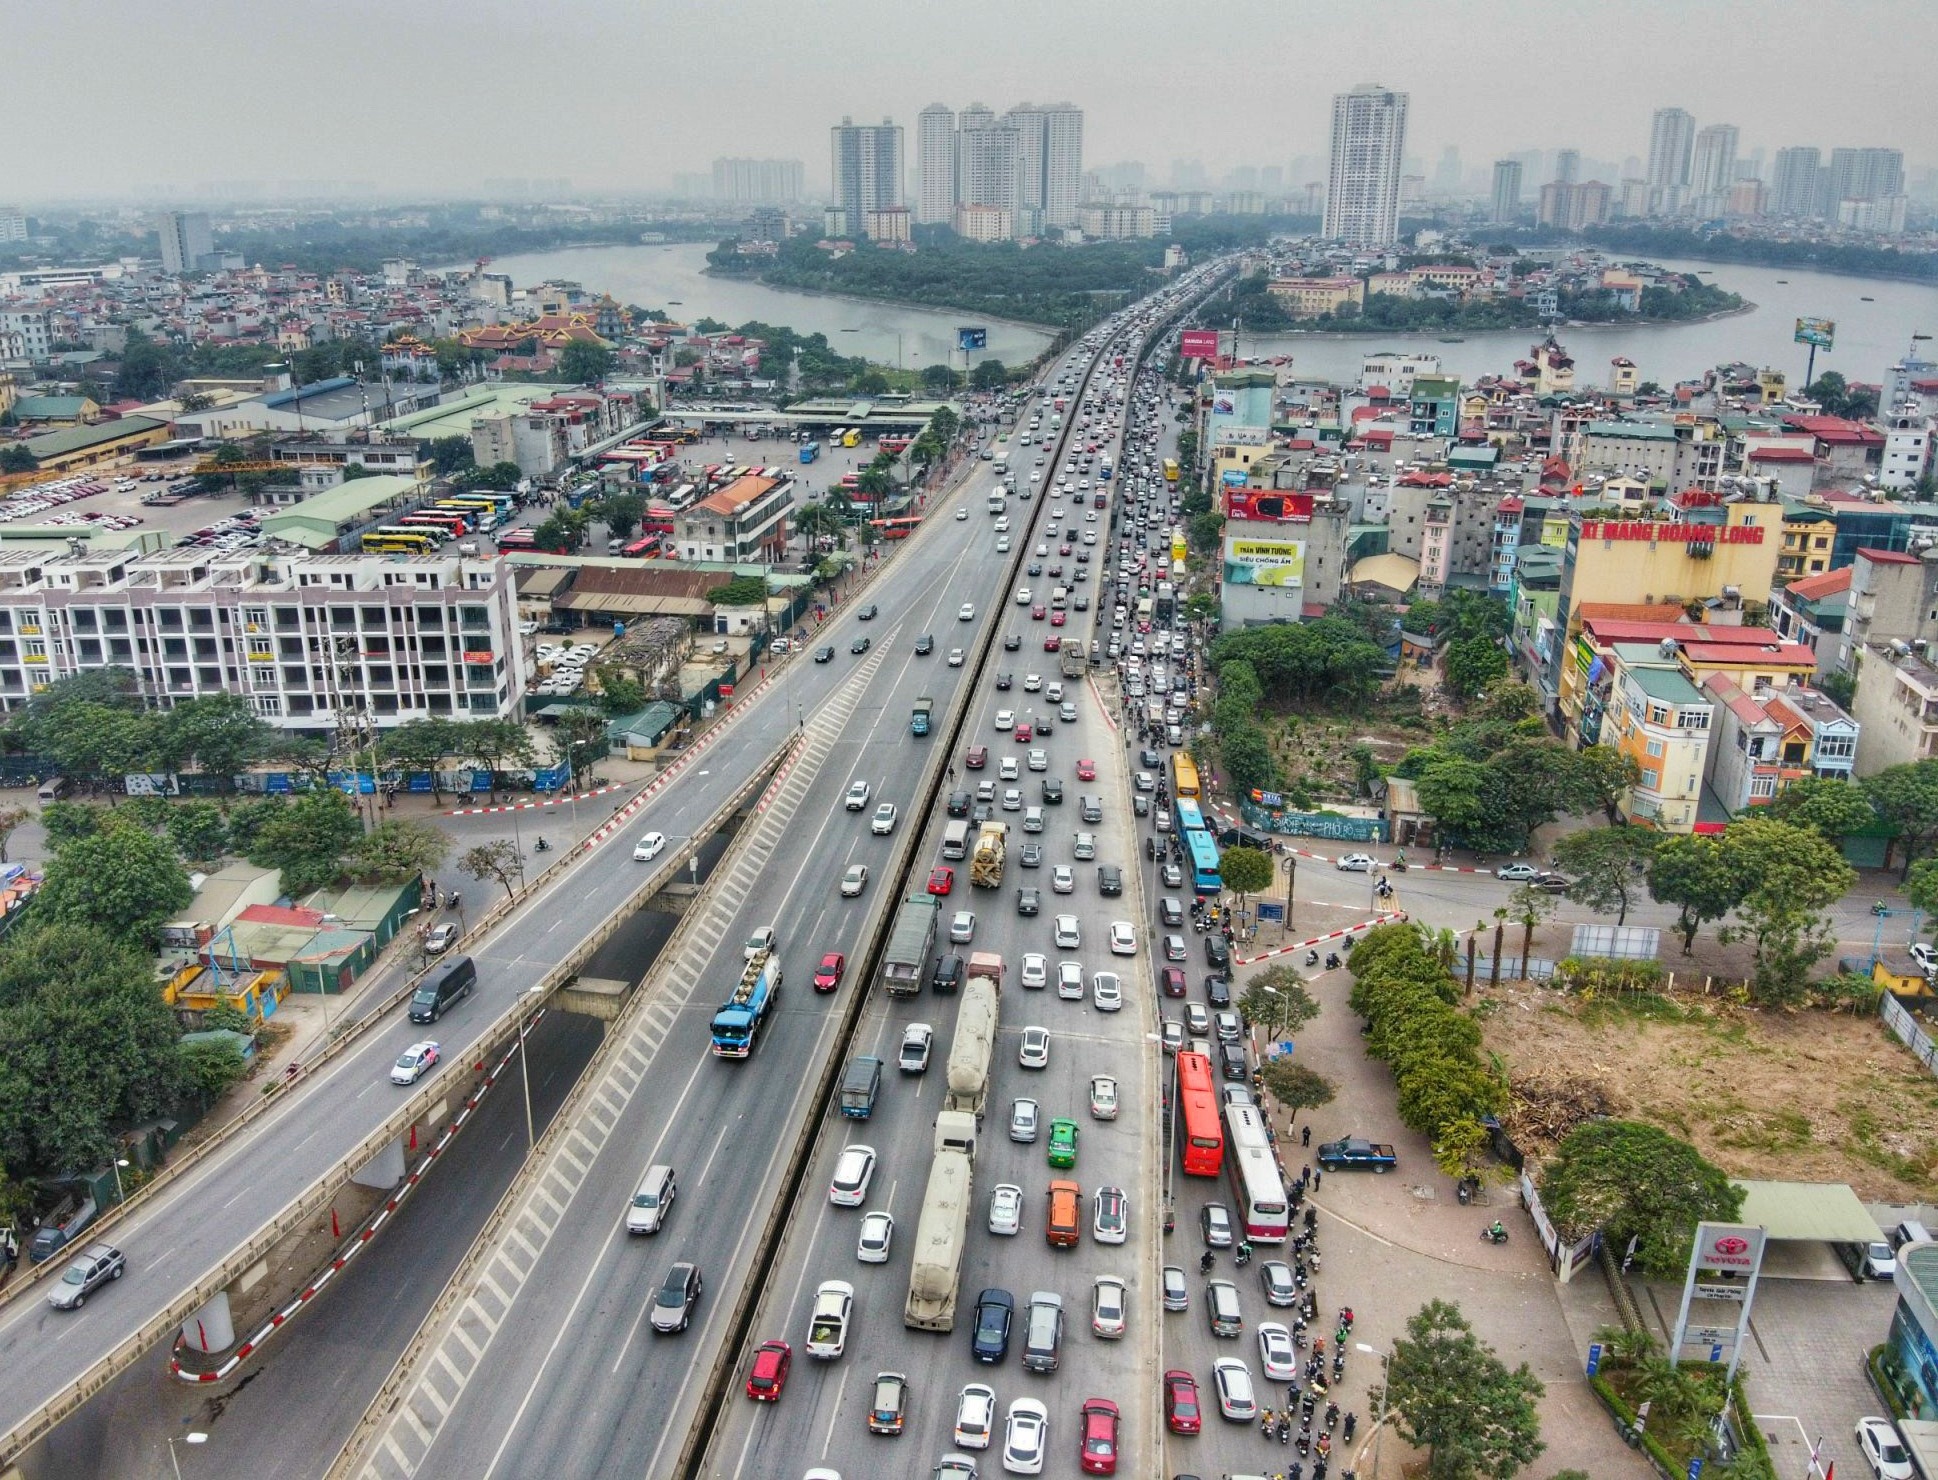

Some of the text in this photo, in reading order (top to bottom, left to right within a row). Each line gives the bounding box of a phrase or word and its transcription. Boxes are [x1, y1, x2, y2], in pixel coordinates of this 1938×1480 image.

[1581, 522, 1598, 539] XI
[1720, 525, 1765, 544] LONG
[1705, 1256, 1750, 1265] TOYOTA
